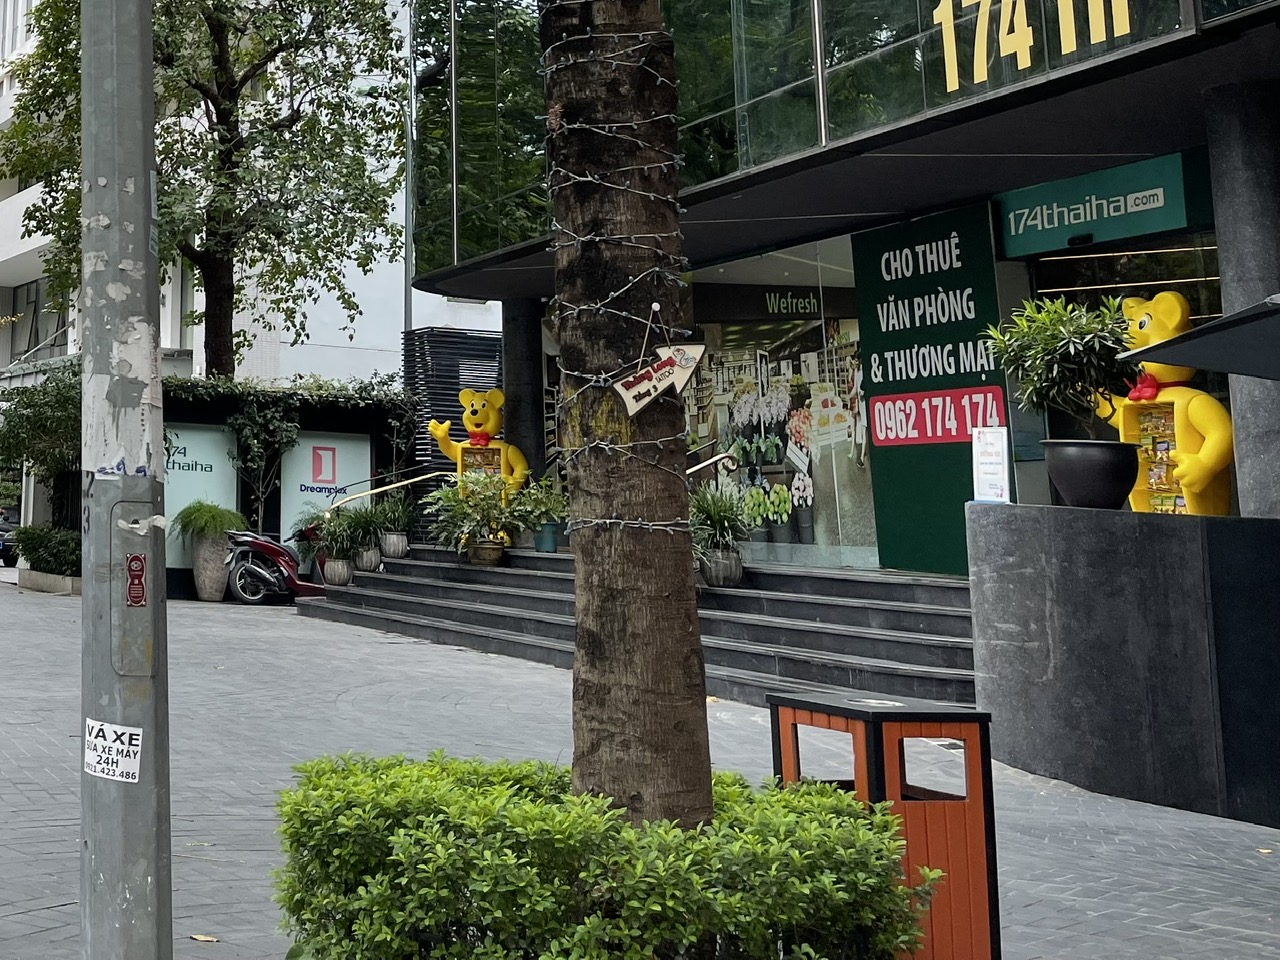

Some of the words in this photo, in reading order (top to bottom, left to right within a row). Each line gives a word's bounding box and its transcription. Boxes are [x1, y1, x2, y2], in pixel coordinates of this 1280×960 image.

[1008, 192, 1160, 236] 174thaiha.com
[880, 247, 914, 282] CHO
[915, 231, 962, 275] THUÊ
[765, 292, 818, 314] Wefresh
[876, 294, 911, 333] VĂN
[913, 286, 976, 328] PHÒNG
[870, 353, 884, 384] &
[884, 343, 956, 382] THƯƠNG
[874, 398, 919, 441] 0962
[921, 396, 958, 438] 174
[961, 392, 1000, 436] 174
[168, 446, 187, 457] 74
[166, 459, 213, 472] thaiha
[87, 723, 108, 742] VÁ
[111, 729, 141, 747] XE
[96, 754, 119, 769] 24H
[100, 744, 113, 756] XE
[116, 746, 139, 760] MÁY
